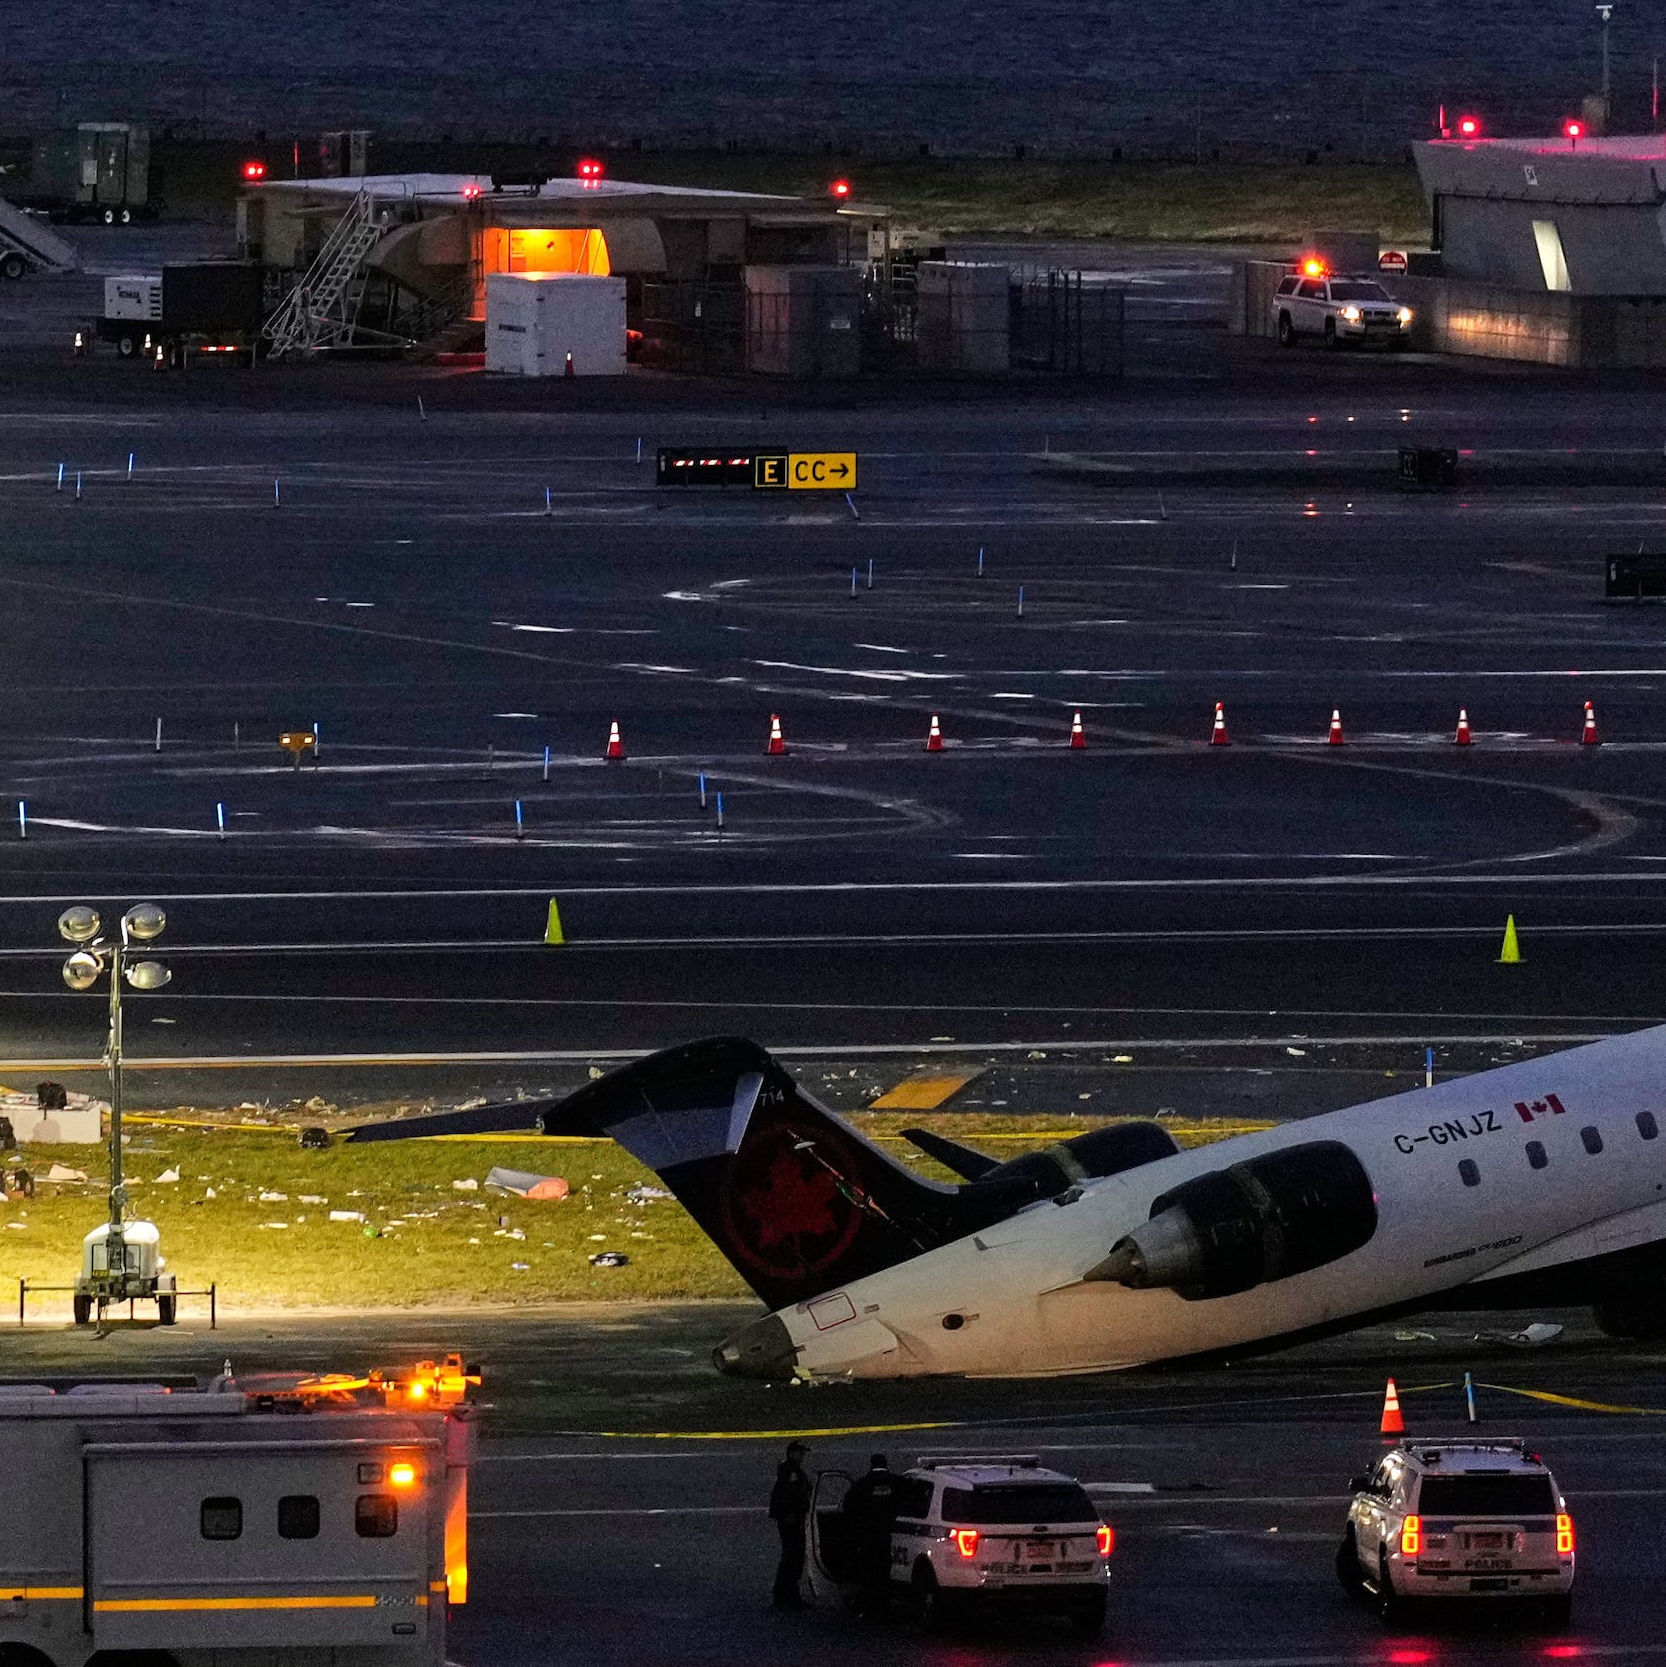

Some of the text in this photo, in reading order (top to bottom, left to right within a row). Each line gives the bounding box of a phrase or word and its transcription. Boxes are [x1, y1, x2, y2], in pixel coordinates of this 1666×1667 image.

[764, 460, 826, 483] E CC
[759, 1088, 785, 1107] 714
[1393, 1109, 1503, 1154] C-GNJZ
[1463, 1559, 1513, 1569] POLICE
